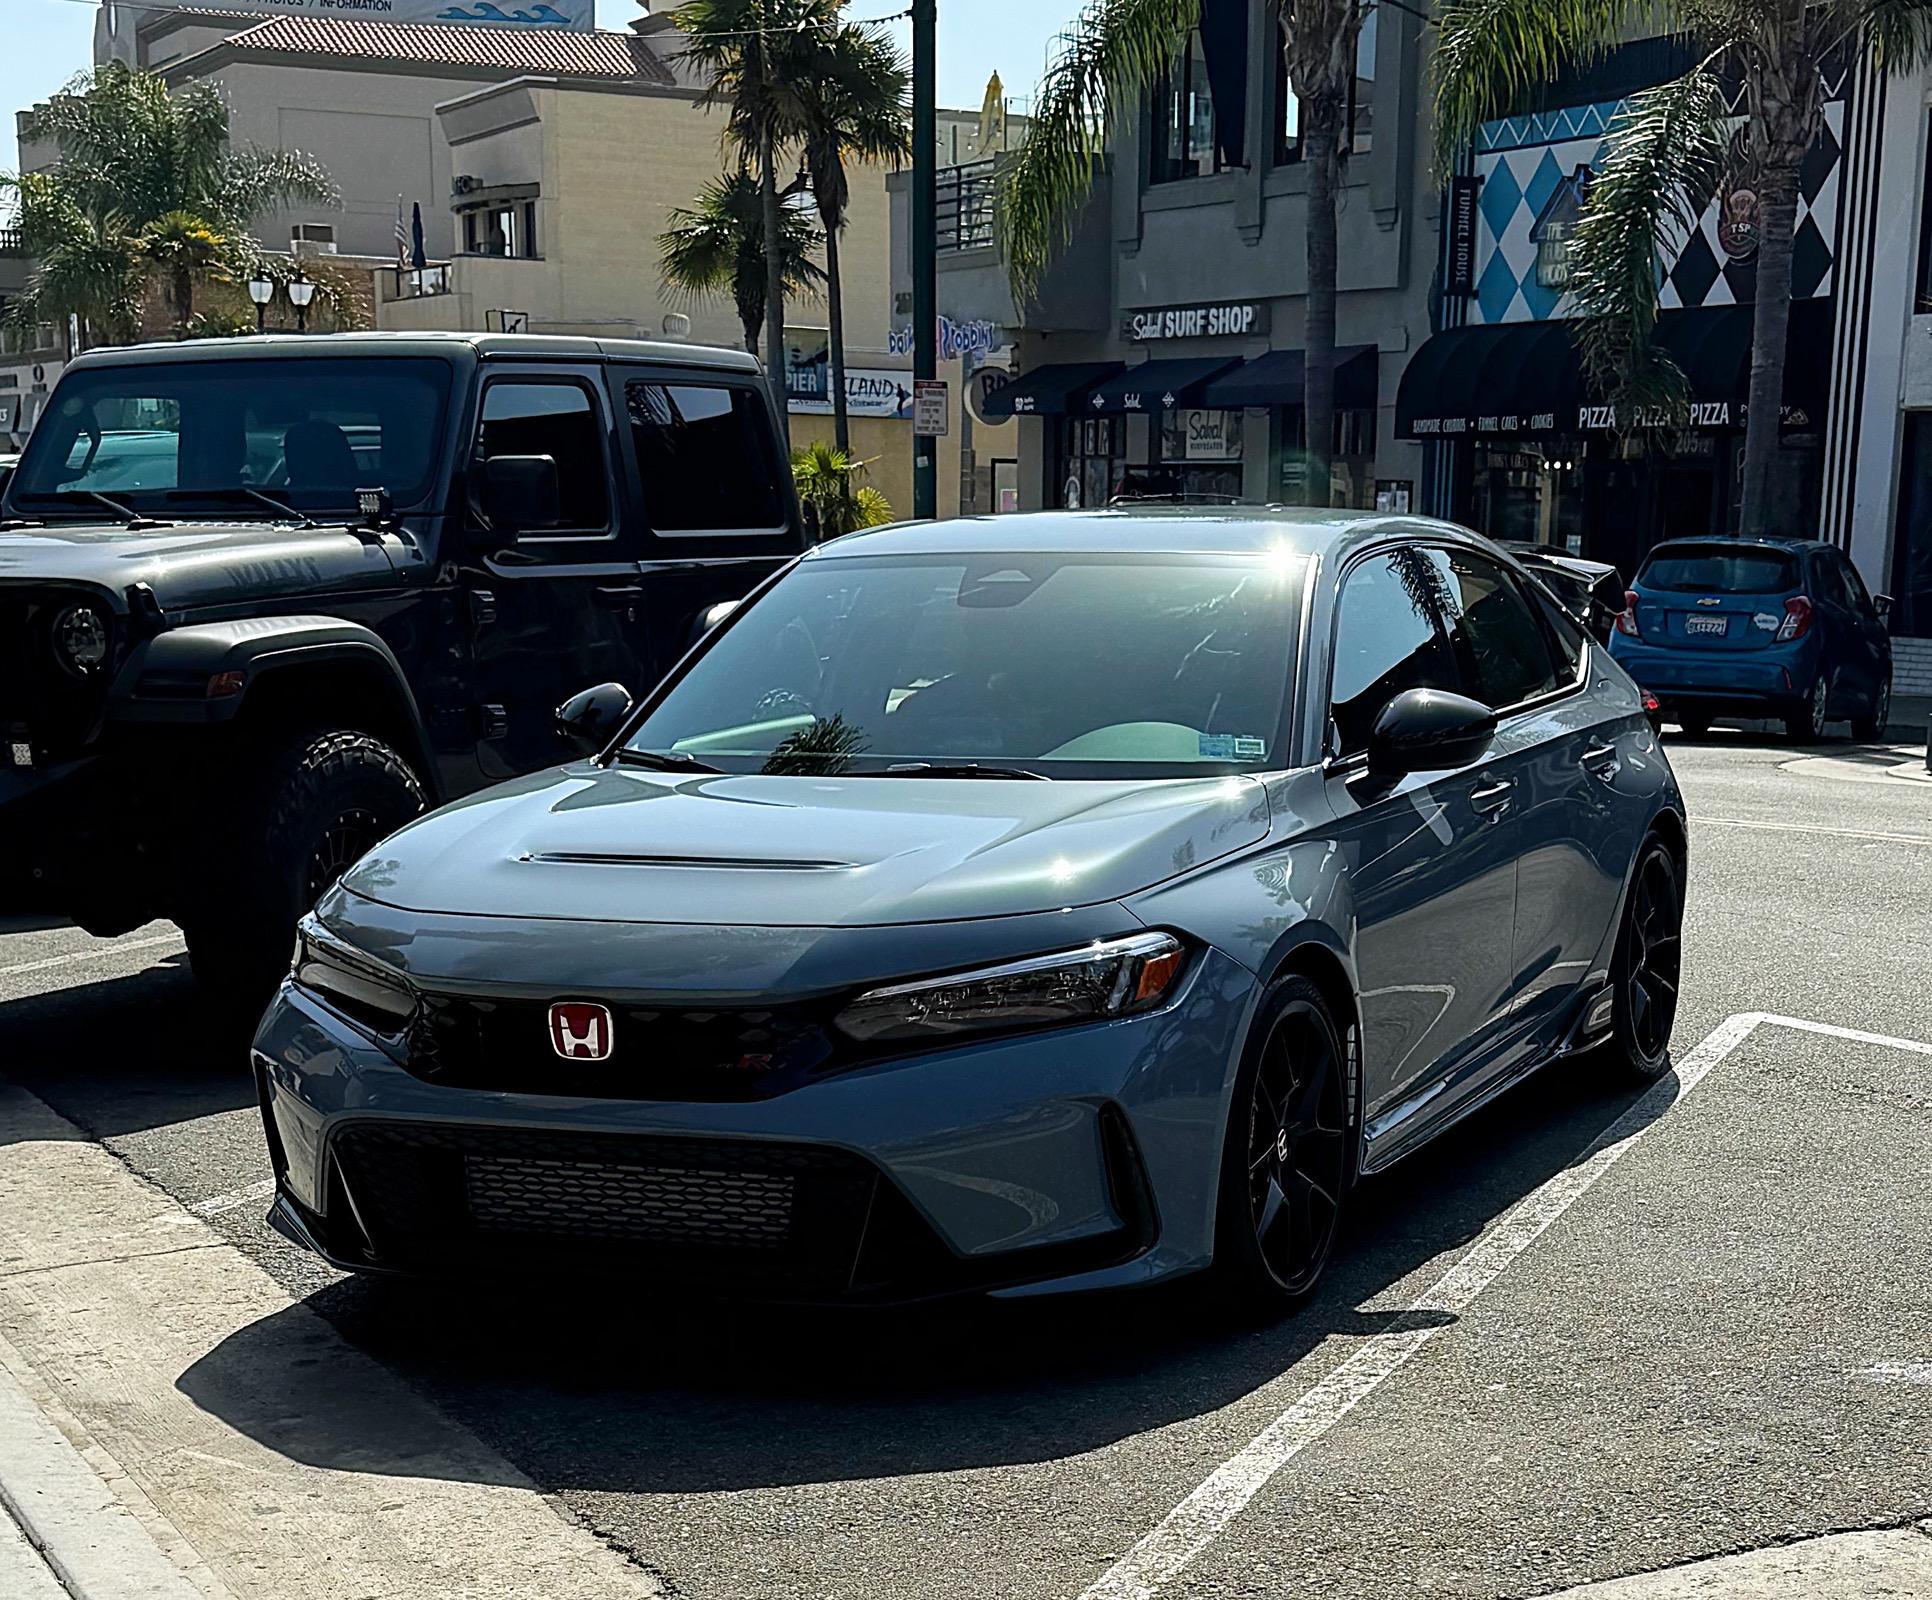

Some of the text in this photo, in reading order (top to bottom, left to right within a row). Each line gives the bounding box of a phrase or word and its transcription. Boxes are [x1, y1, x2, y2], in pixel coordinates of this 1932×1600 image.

[320, 0, 392, 11] INFORMATION
[1455, 188, 1471, 285] FUNNEL HOUSE
[1546, 221, 1565, 240] THE
[1731, 222, 1751, 233] TSP
[1165, 310, 1207, 338] SURF
[1207, 306, 1253, 335] SHOP
[785, 372, 818, 393] PIER
[846, 377, 893, 398] LAND
[1579, 406, 1616, 428] PIZZA
[1689, 402, 1729, 425] PIZZA
